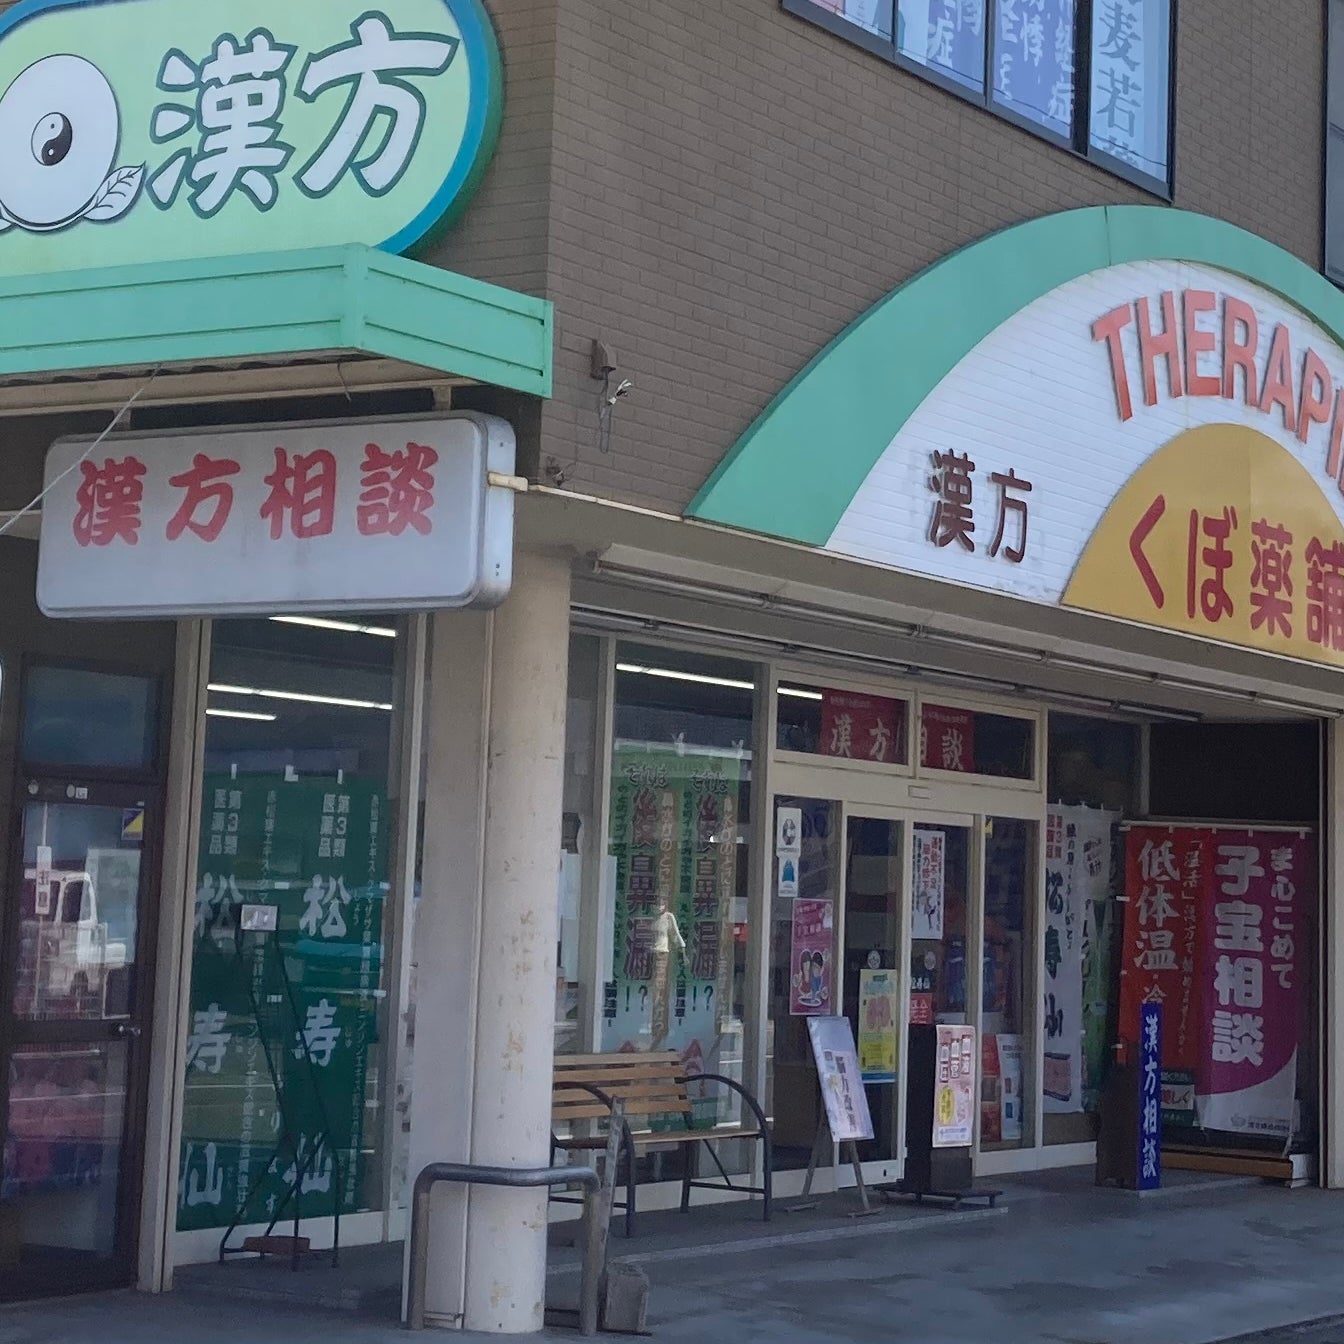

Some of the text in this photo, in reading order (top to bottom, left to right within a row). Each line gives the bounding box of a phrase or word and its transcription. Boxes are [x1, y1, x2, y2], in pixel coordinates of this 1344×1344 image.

[145, 9, 460, 219] 漢方
[73, 442, 438, 546] 漢方相談
[927, 449, 1033, 563] 漢方
[1212, 845, 1266, 1067] 子宝相談
[1142, 1013, 1159, 1180] 漢方相談
